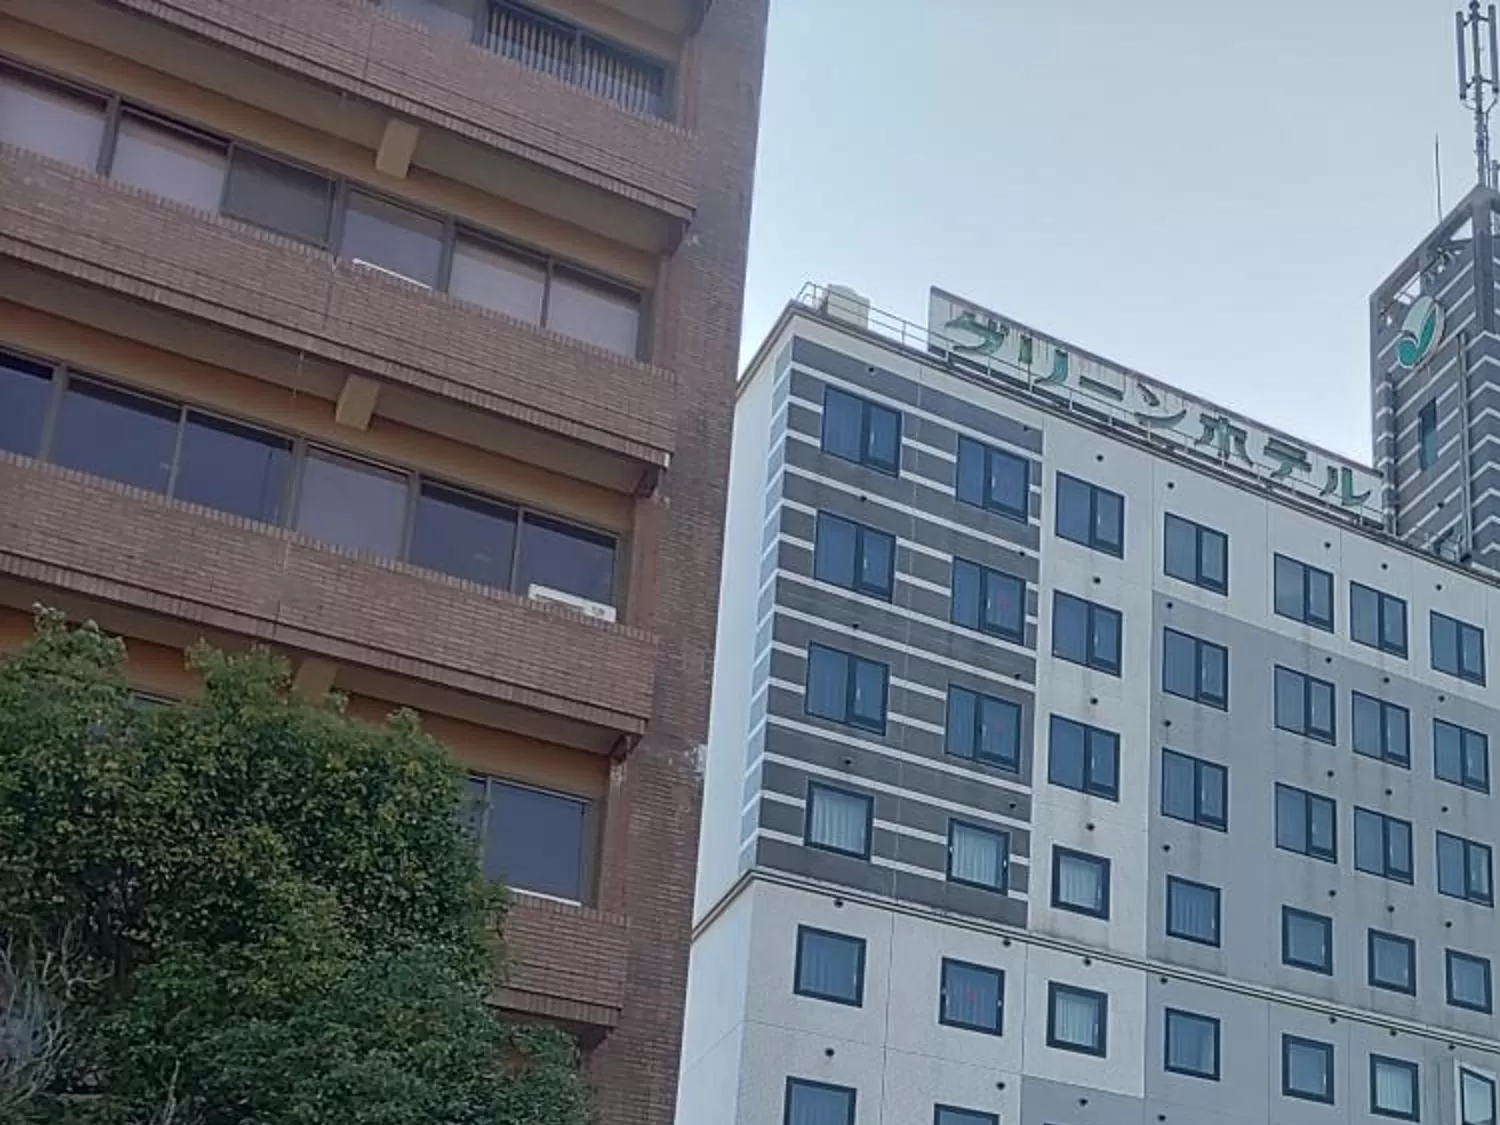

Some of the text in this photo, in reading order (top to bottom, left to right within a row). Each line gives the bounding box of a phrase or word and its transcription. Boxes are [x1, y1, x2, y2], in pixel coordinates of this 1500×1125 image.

[944, 310, 1371, 507] グリーンホテル
